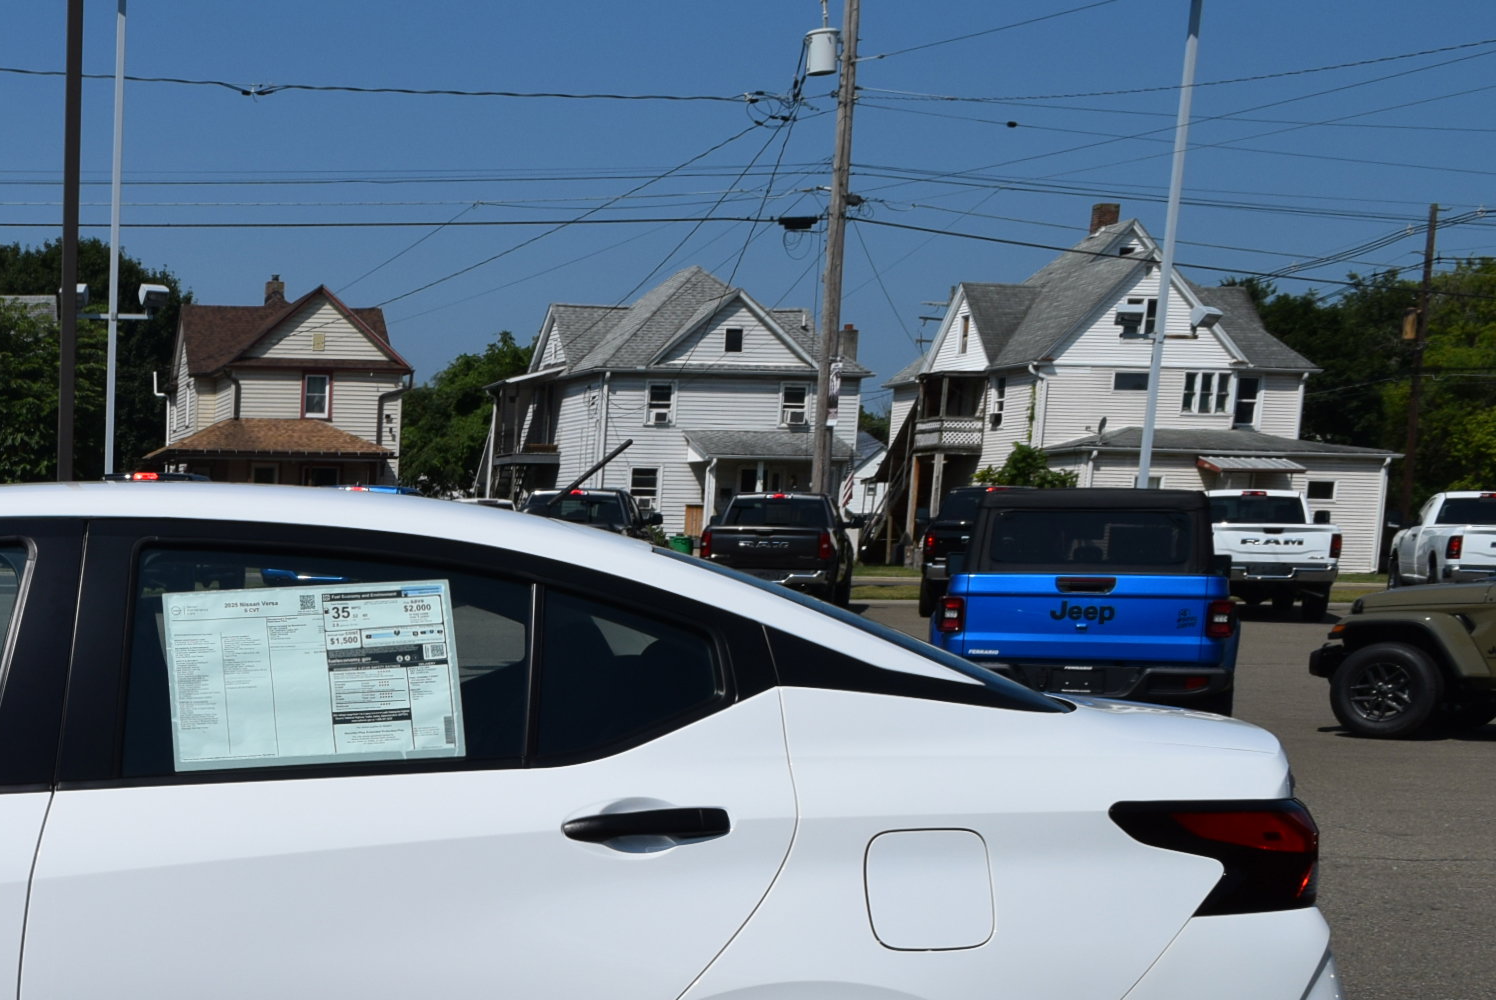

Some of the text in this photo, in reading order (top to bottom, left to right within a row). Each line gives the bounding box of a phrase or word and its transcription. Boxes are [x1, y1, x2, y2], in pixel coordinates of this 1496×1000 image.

[332, 606, 350, 619] 35
[403, 603, 431, 613] $2,000
[1050, 601, 1115, 624] Jeep
[330, 636, 358, 645] $1,500
